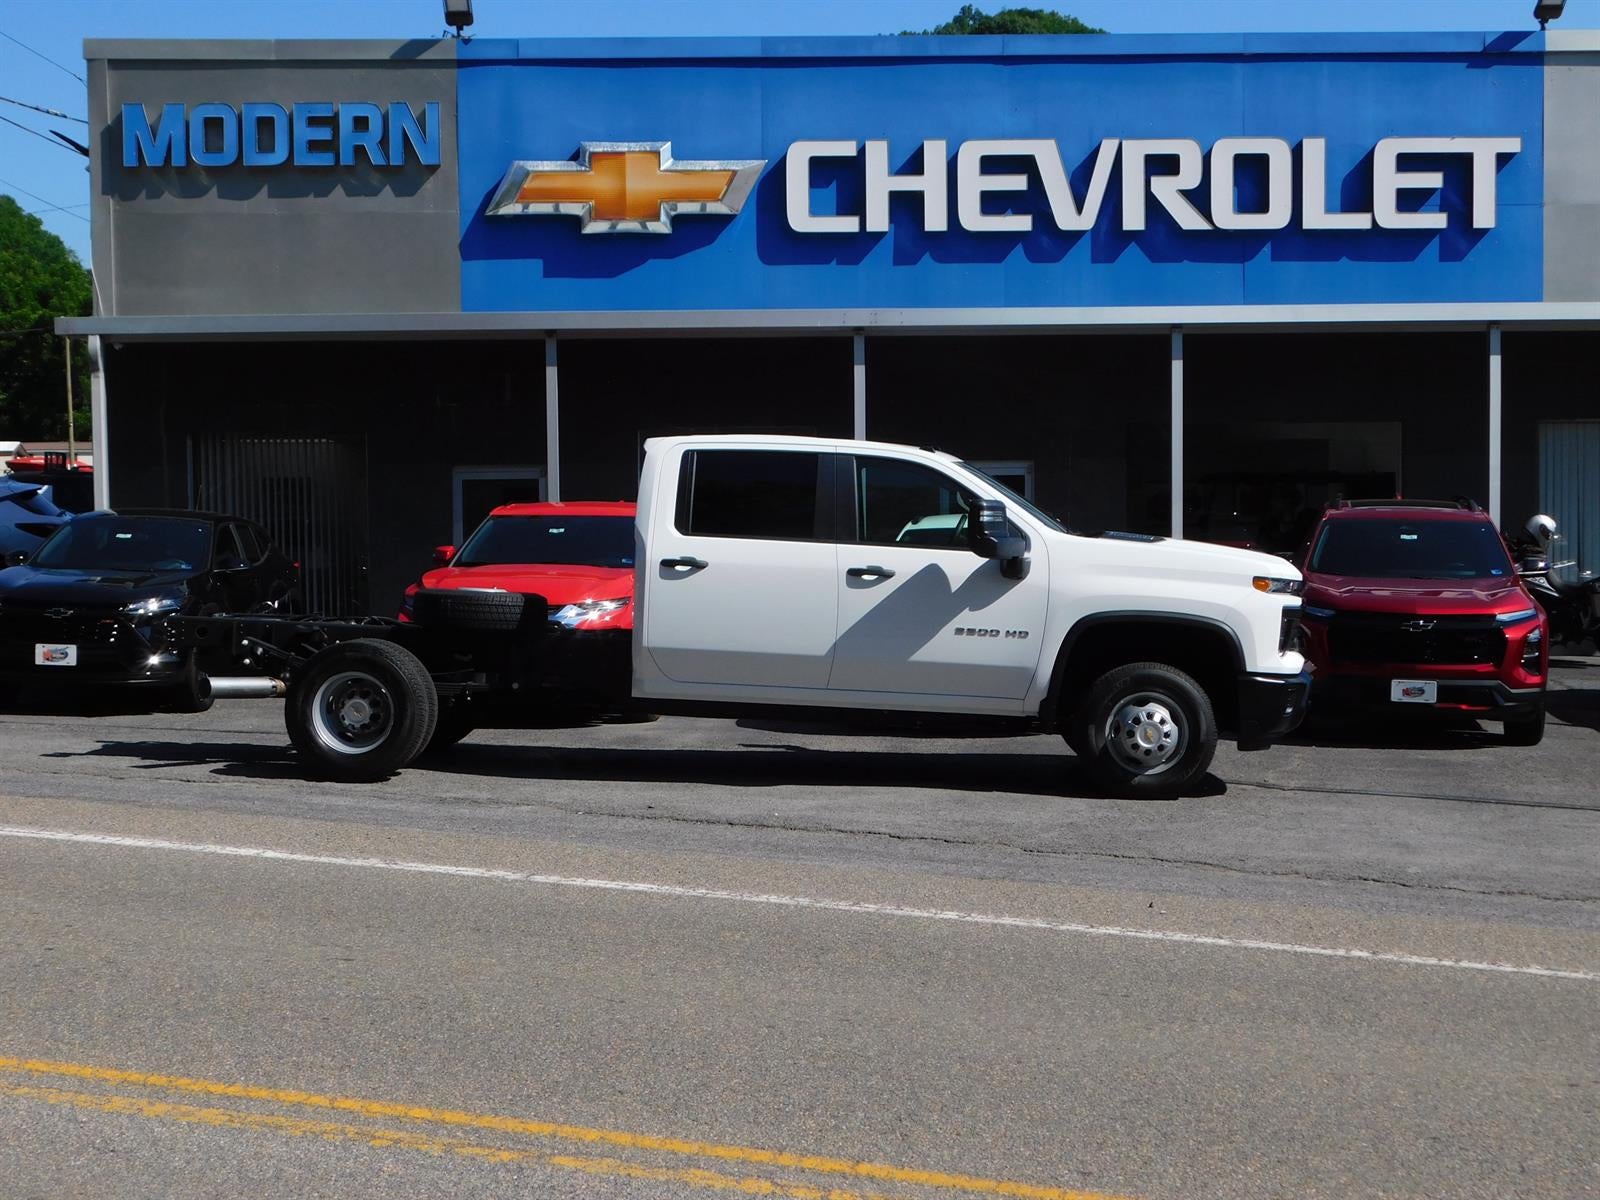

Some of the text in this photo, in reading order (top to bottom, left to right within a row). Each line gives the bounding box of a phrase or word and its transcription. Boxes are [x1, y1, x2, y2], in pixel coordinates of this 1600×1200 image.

[121, 101, 441, 168] MODERN
[786, 136, 1522, 233] CHEVROLET
[1004, 629, 1030, 640] HD
